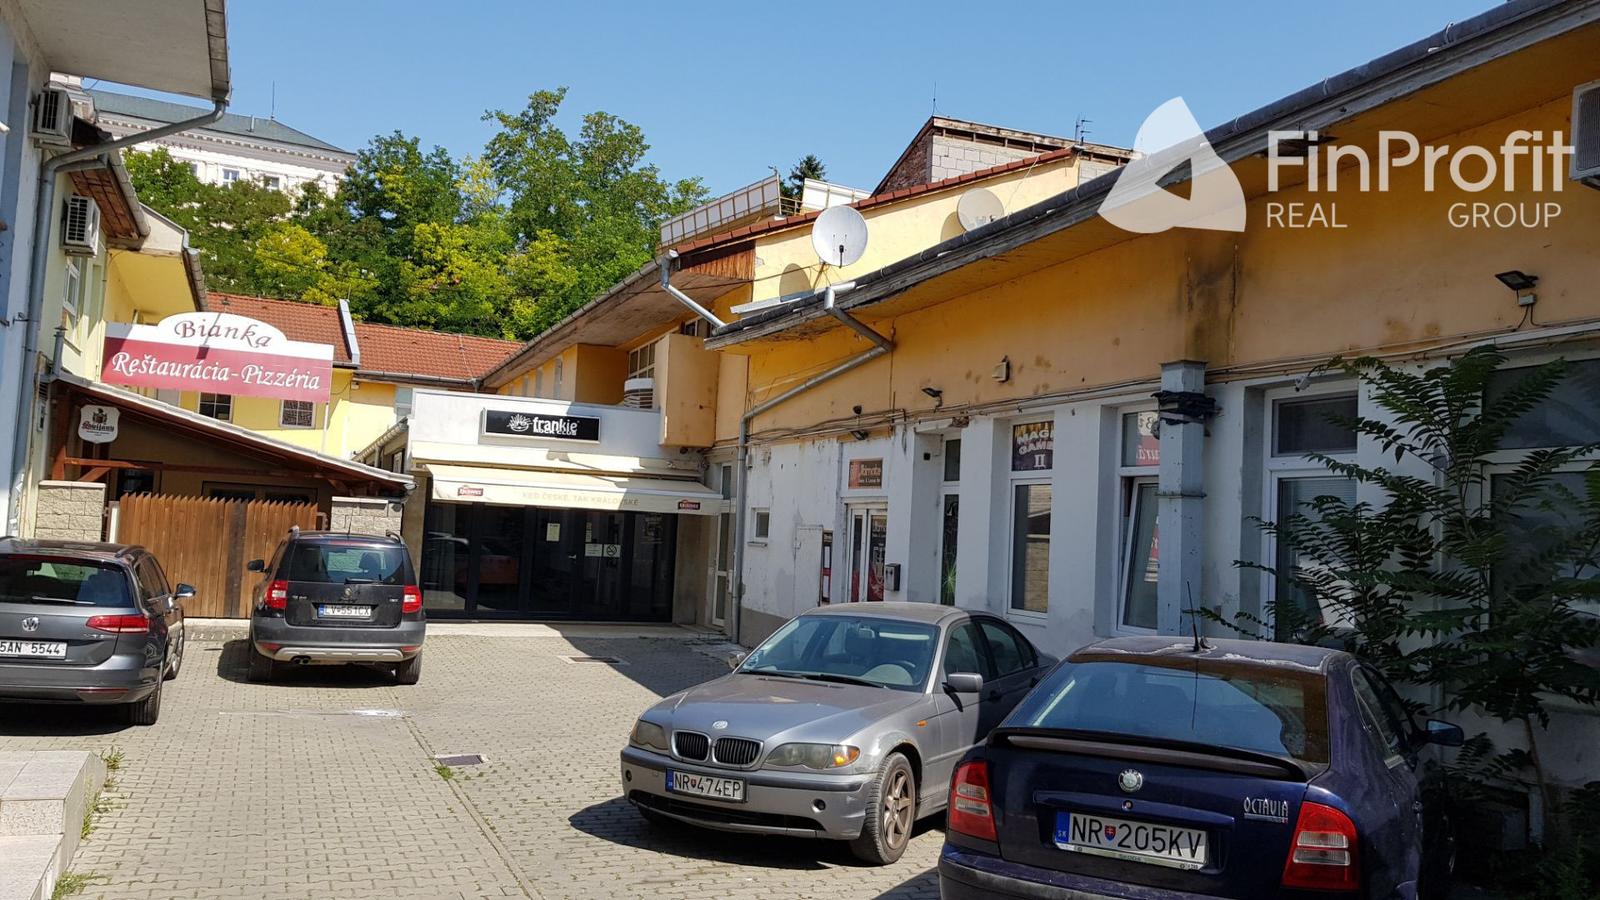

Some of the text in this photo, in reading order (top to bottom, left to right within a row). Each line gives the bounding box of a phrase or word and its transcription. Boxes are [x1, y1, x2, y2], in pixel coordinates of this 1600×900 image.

[174, 318, 272, 348] Bianka
[532, 416, 578, 432] frankie
[0, 641, 61, 655] 5AN 5544
[1243, 796, 1289, 817] OCTAVIA
